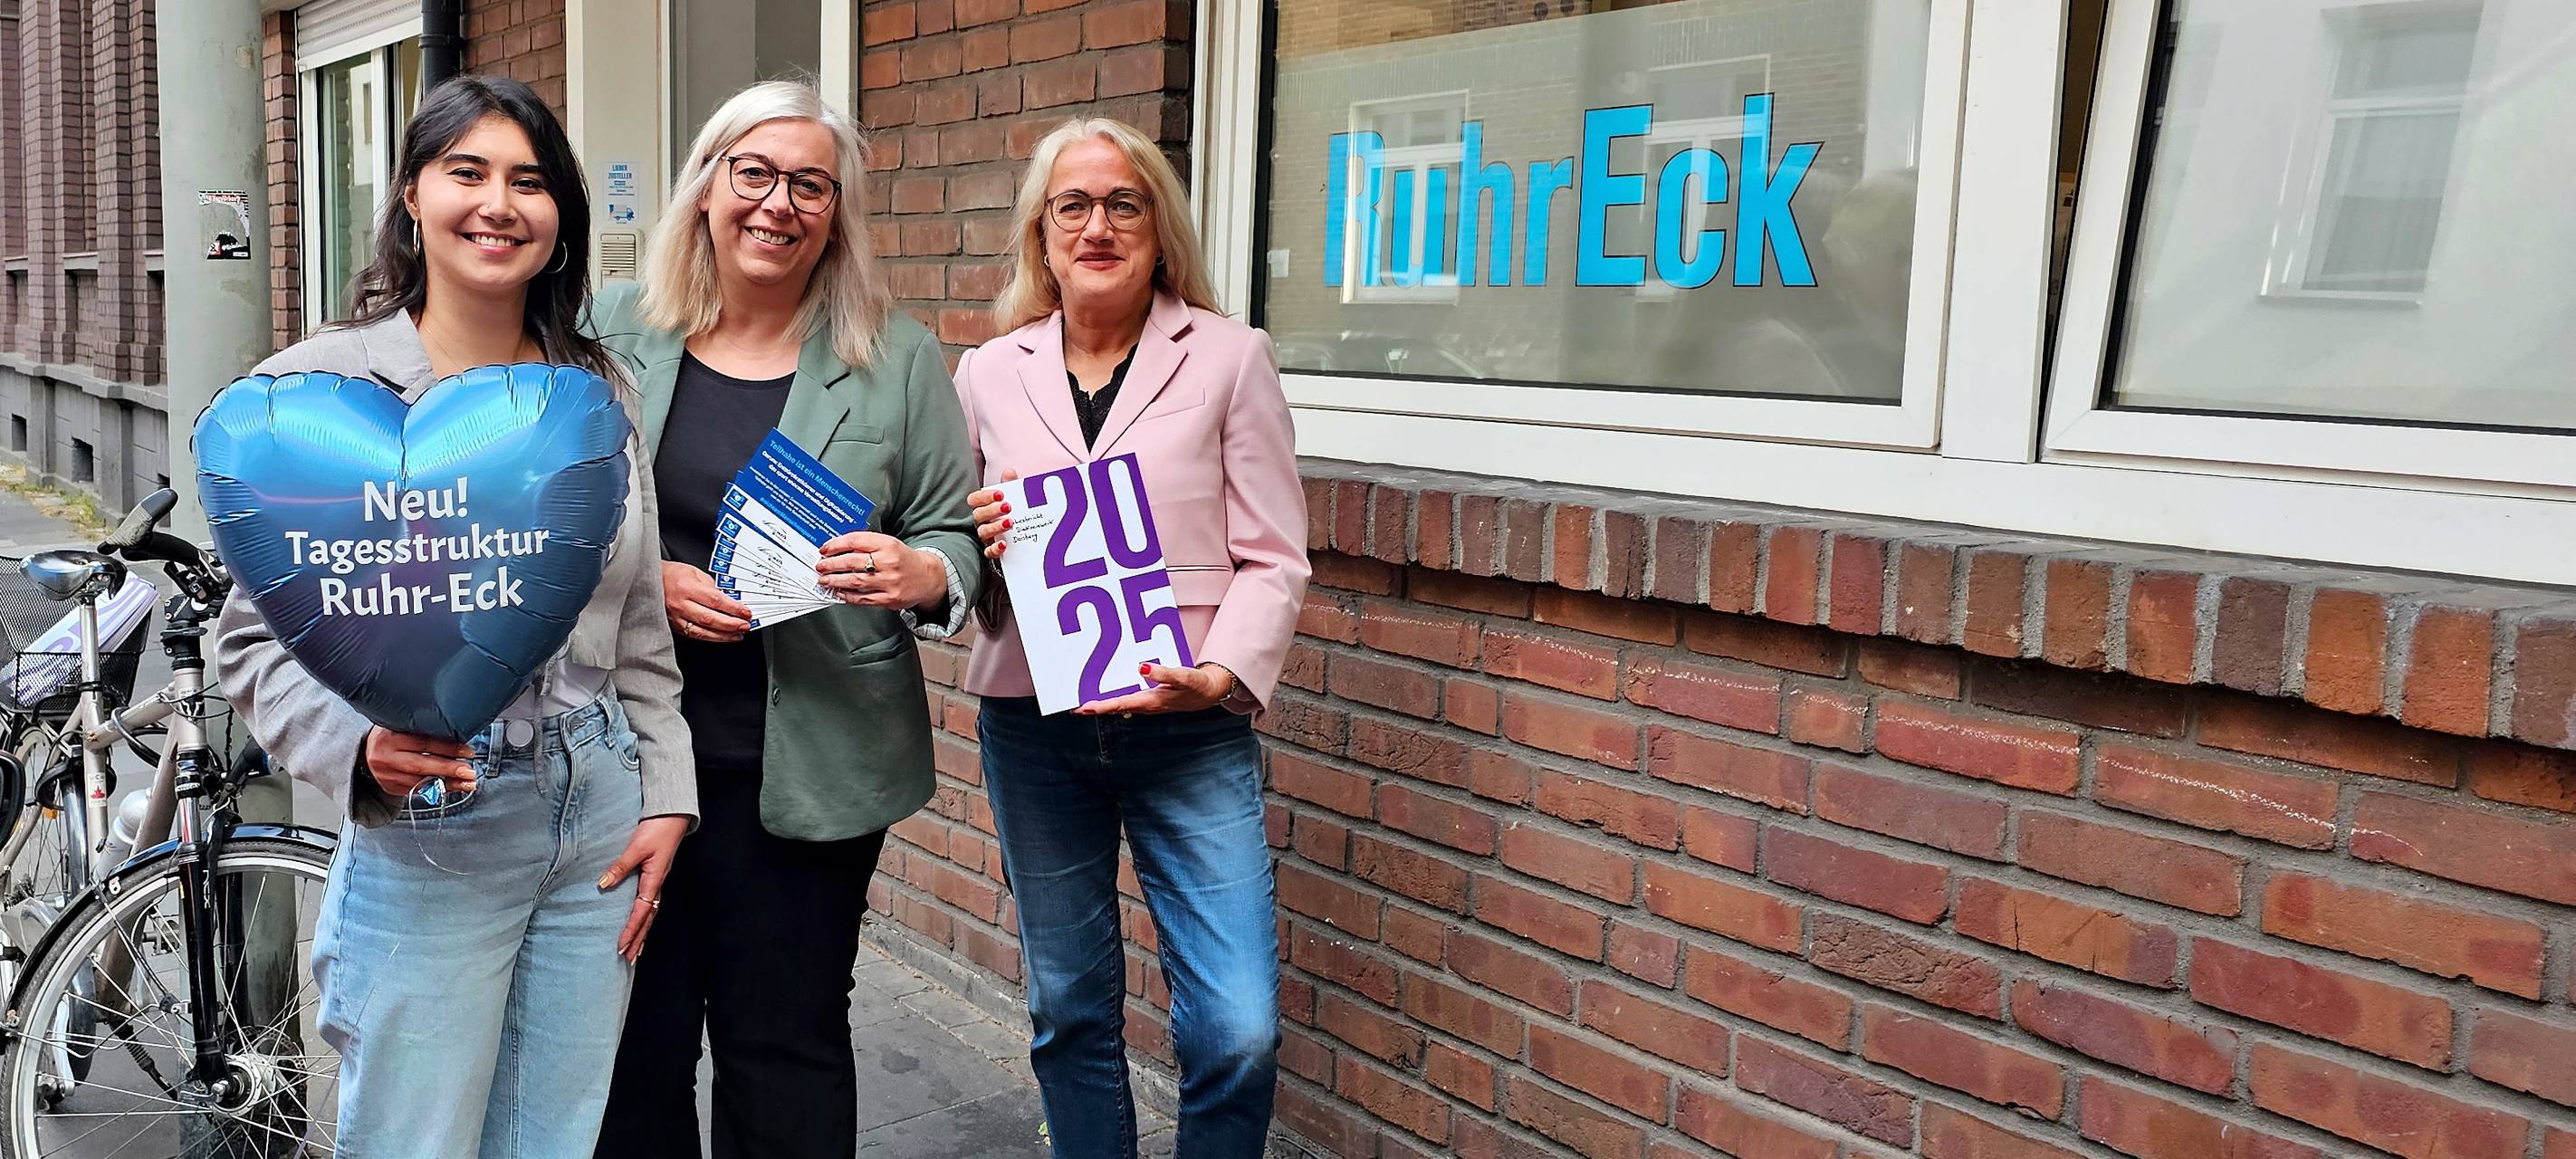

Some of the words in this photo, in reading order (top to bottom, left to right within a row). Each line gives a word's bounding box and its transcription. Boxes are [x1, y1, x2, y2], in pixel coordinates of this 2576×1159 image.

[1325, 92, 1824, 289] RuhrEck
[364, 476, 468, 522] Neu!
[771, 440, 796, 463] Teilhabe
[796, 460, 805, 470] ist
[804, 468, 814, 478] ein
[815, 475, 865, 515] Menschenrecht!
[285, 522, 549, 574] Tagesstruktur
[1023, 453, 1164, 589] 20
[320, 566, 524, 618] Ruhr-Eck
